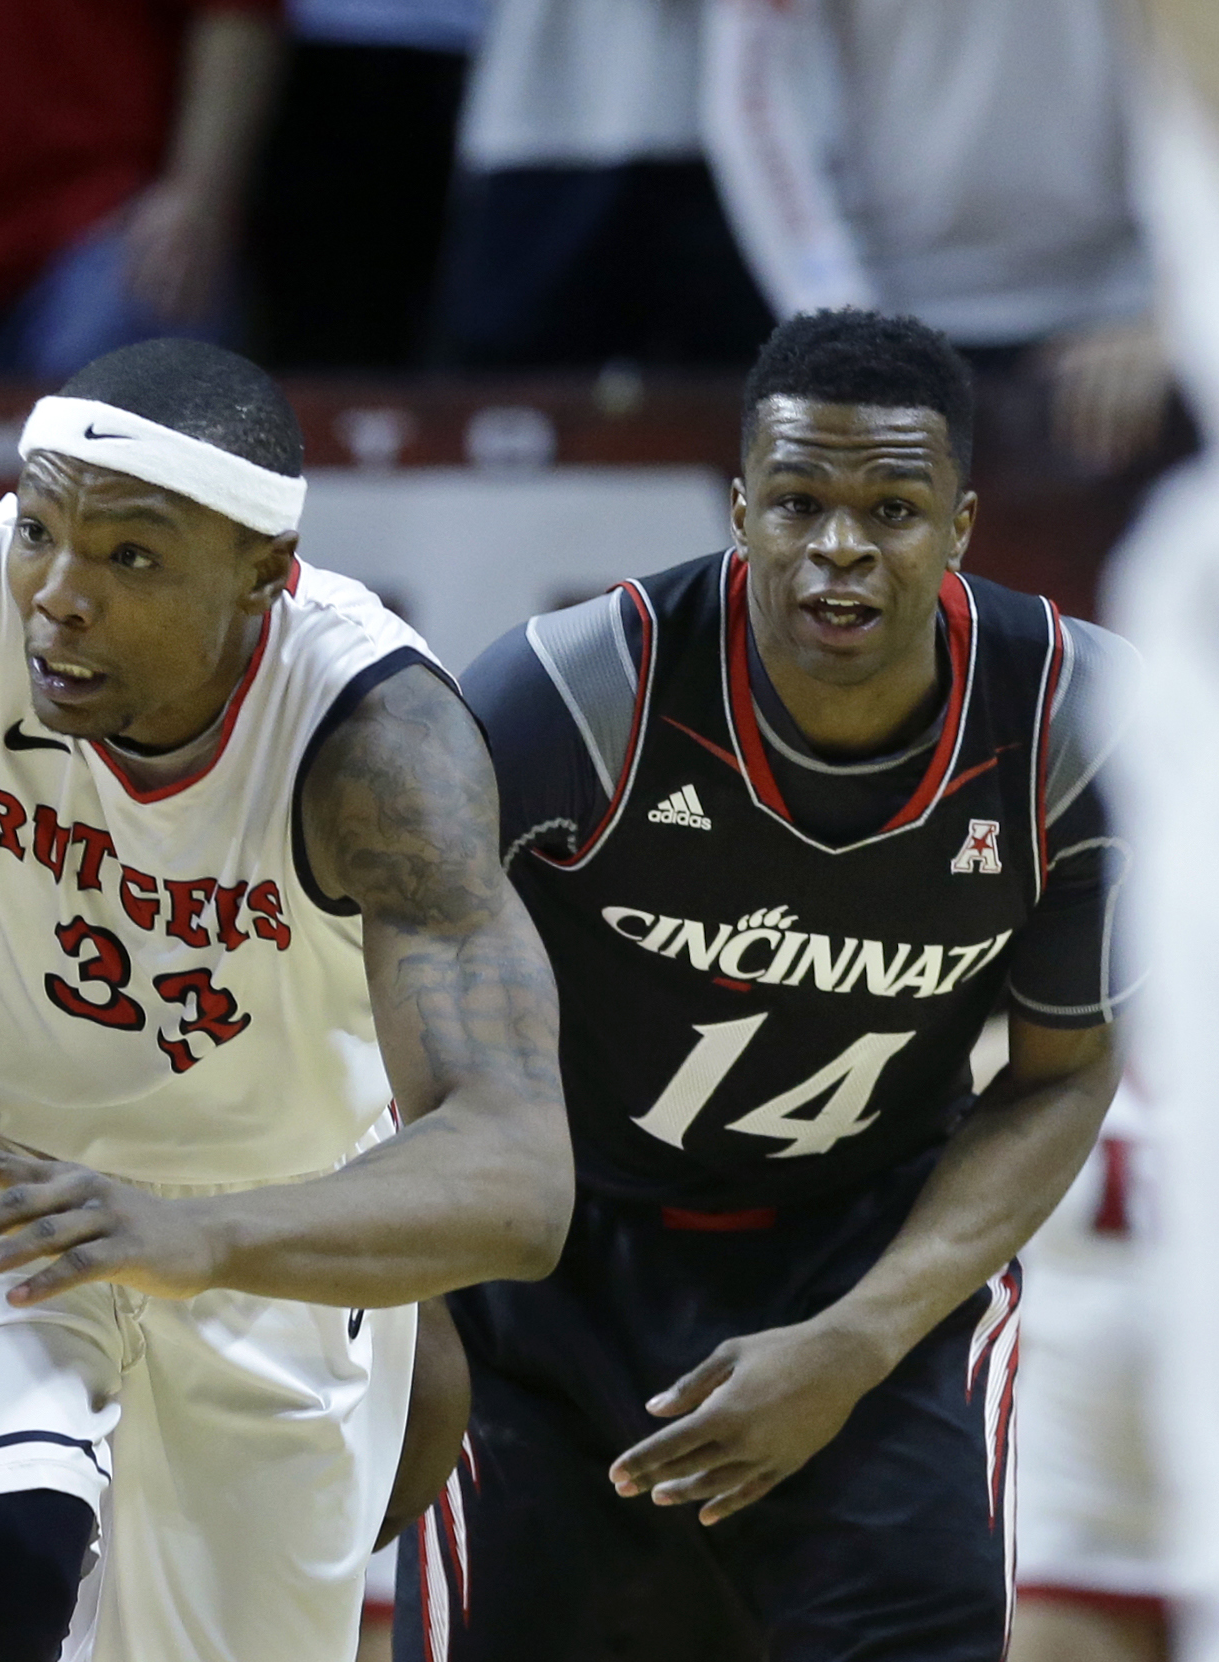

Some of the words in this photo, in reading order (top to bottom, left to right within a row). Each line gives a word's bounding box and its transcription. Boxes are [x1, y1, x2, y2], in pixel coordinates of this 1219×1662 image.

[647, 807, 712, 831] adidas
[601, 906, 1013, 998] CINCINNATI
[629, 1012, 917, 1158] 14
